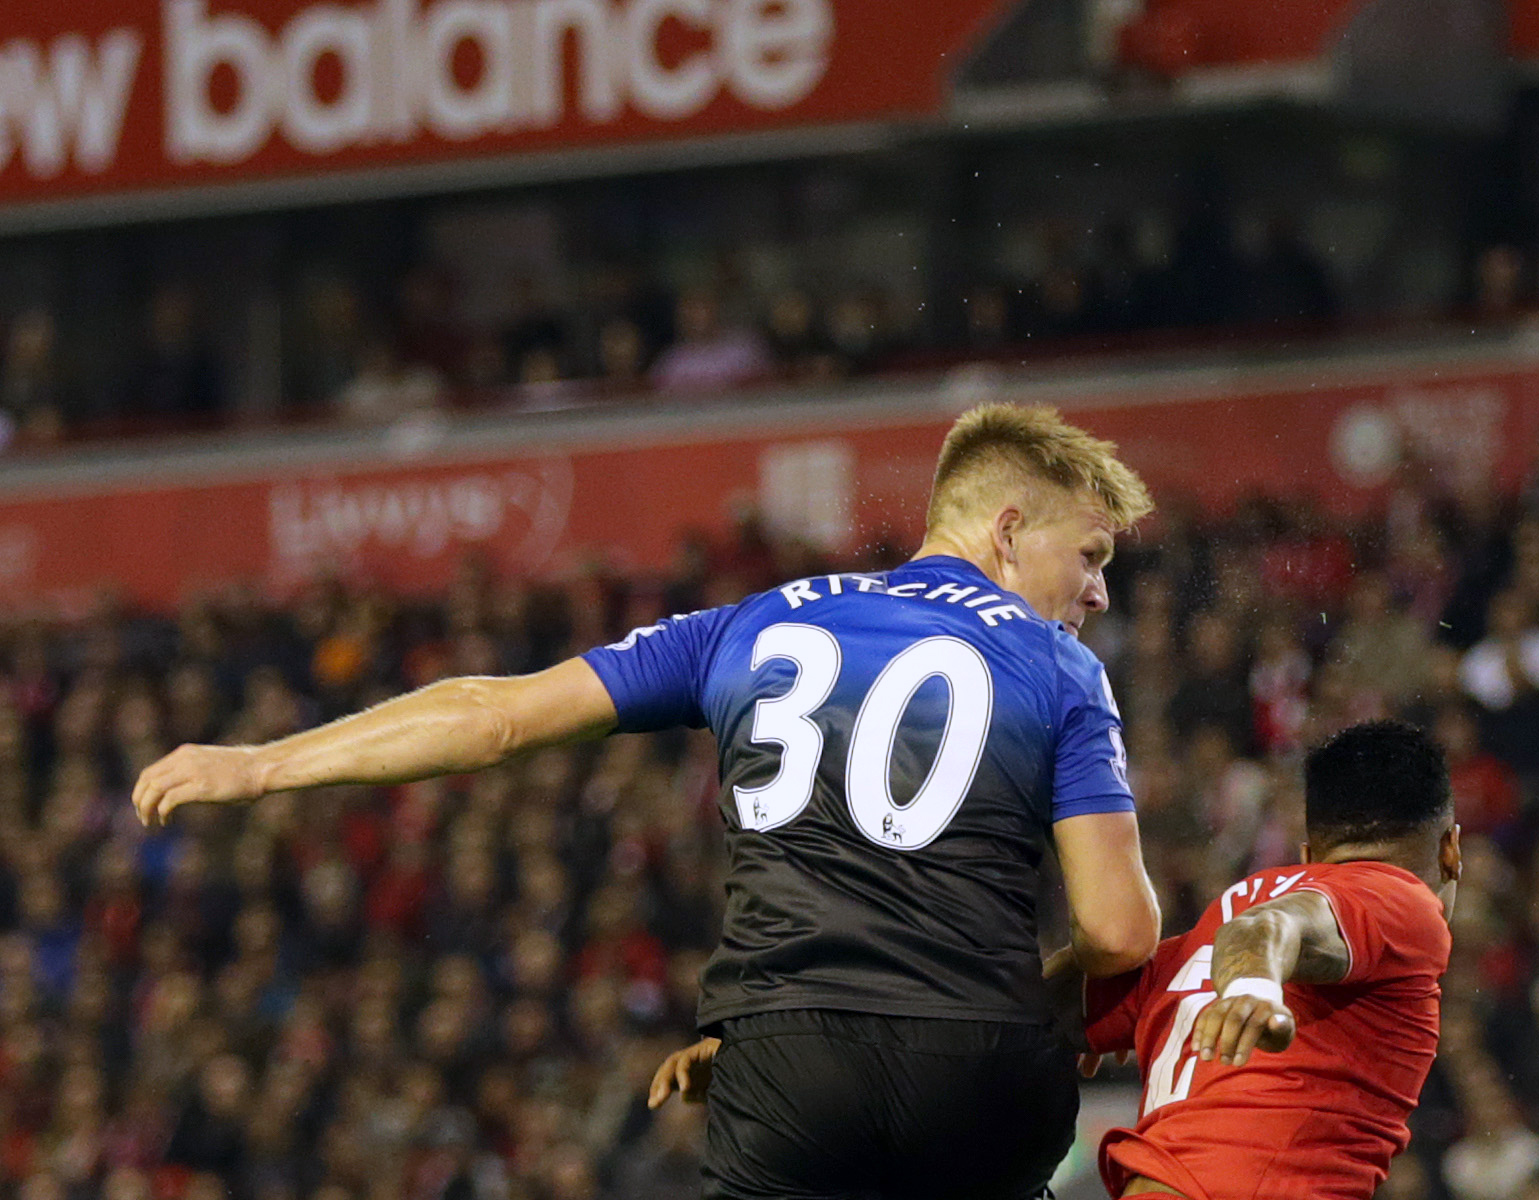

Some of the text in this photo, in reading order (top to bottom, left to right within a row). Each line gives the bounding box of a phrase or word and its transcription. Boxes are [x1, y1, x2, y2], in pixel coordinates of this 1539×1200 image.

[163, 0, 836, 163] balance
[780, 573, 1027, 629] RITCHIE
[732, 622, 994, 852] 30
